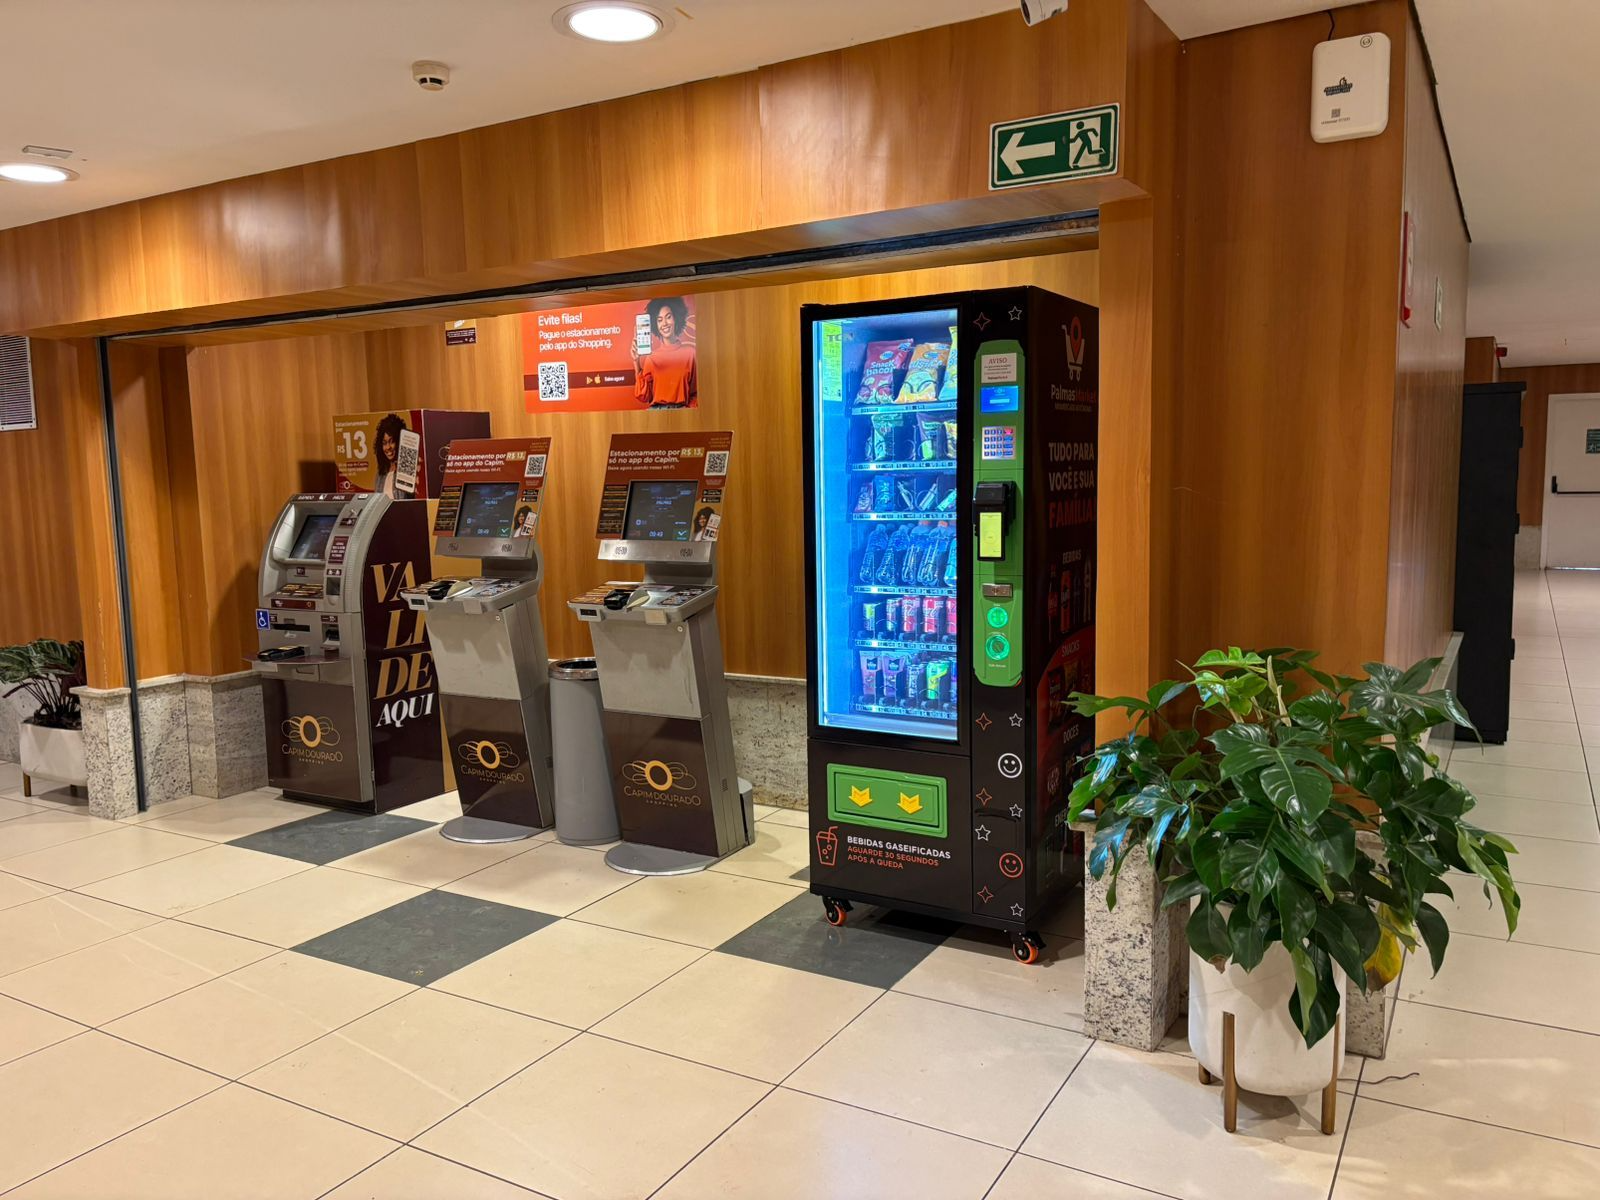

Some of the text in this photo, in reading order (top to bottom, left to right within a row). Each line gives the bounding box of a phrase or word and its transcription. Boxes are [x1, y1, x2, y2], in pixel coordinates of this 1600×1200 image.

[538, 312, 583, 326] Evite filas!
[539, 330, 560, 342] Pague
[566, 326, 620, 338] estacionamento
[540, 342, 554, 352] pelo
[568, 340, 578, 348] do
[578, 338, 612, 350] Shopping.
[871, 360, 895, 368] Snack
[343, 430, 368, 460] 13
[668, 450, 680, 458] por
[1048, 442, 1094, 462] TUDO PARA
[654, 456, 679, 464] Capim.
[1048, 466, 1095, 492] VOCÊ E SUA
[374, 650, 434, 700] DE
[376, 693, 434, 728] AQUI
[1063, 726, 1080, 744] DOCES
[847, 836, 951, 859] BEBIDAS GASEIFICADAS
[848, 846, 939, 867] AGUARDE 30 SEGUNDOS
[848, 854, 867, 864] APÓS
[878, 859, 904, 870] QUEDA
